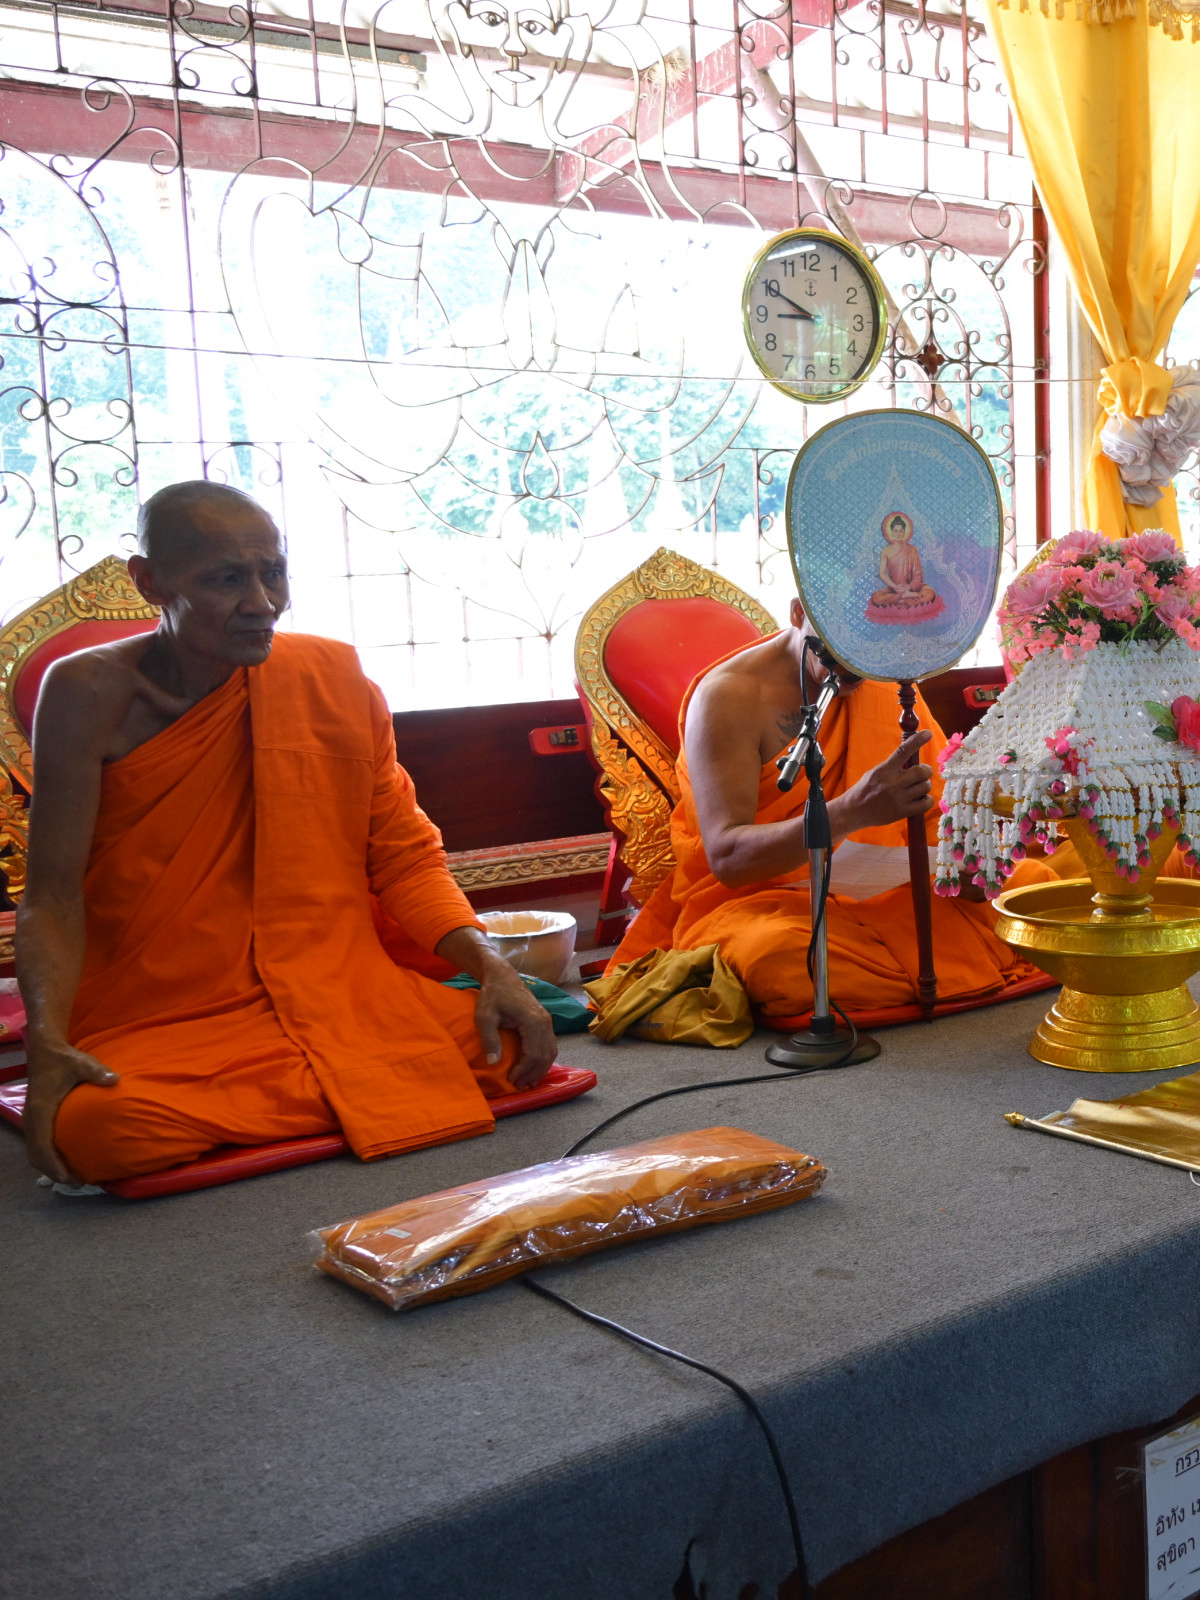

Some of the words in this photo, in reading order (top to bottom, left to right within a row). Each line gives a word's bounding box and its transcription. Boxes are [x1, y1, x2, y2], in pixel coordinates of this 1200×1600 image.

[781, 259, 795, 278] 11
[800, 253, 821, 272] 12
[830, 264, 838, 282] 1
[761, 279, 780, 298] 10
[846, 287, 858, 305] 2
[756, 305, 768, 323] 9
[852, 315, 864, 332] 3
[765, 333, 777, 351] 8
[847, 339, 858, 357] 4
[782, 354, 795, 372] 7
[804, 364, 816, 380] 6
[829, 358, 840, 376] 5
[1155, 1505, 1185, 1536] อิทัง
[1156, 1536, 1195, 1572] สุขิตา
